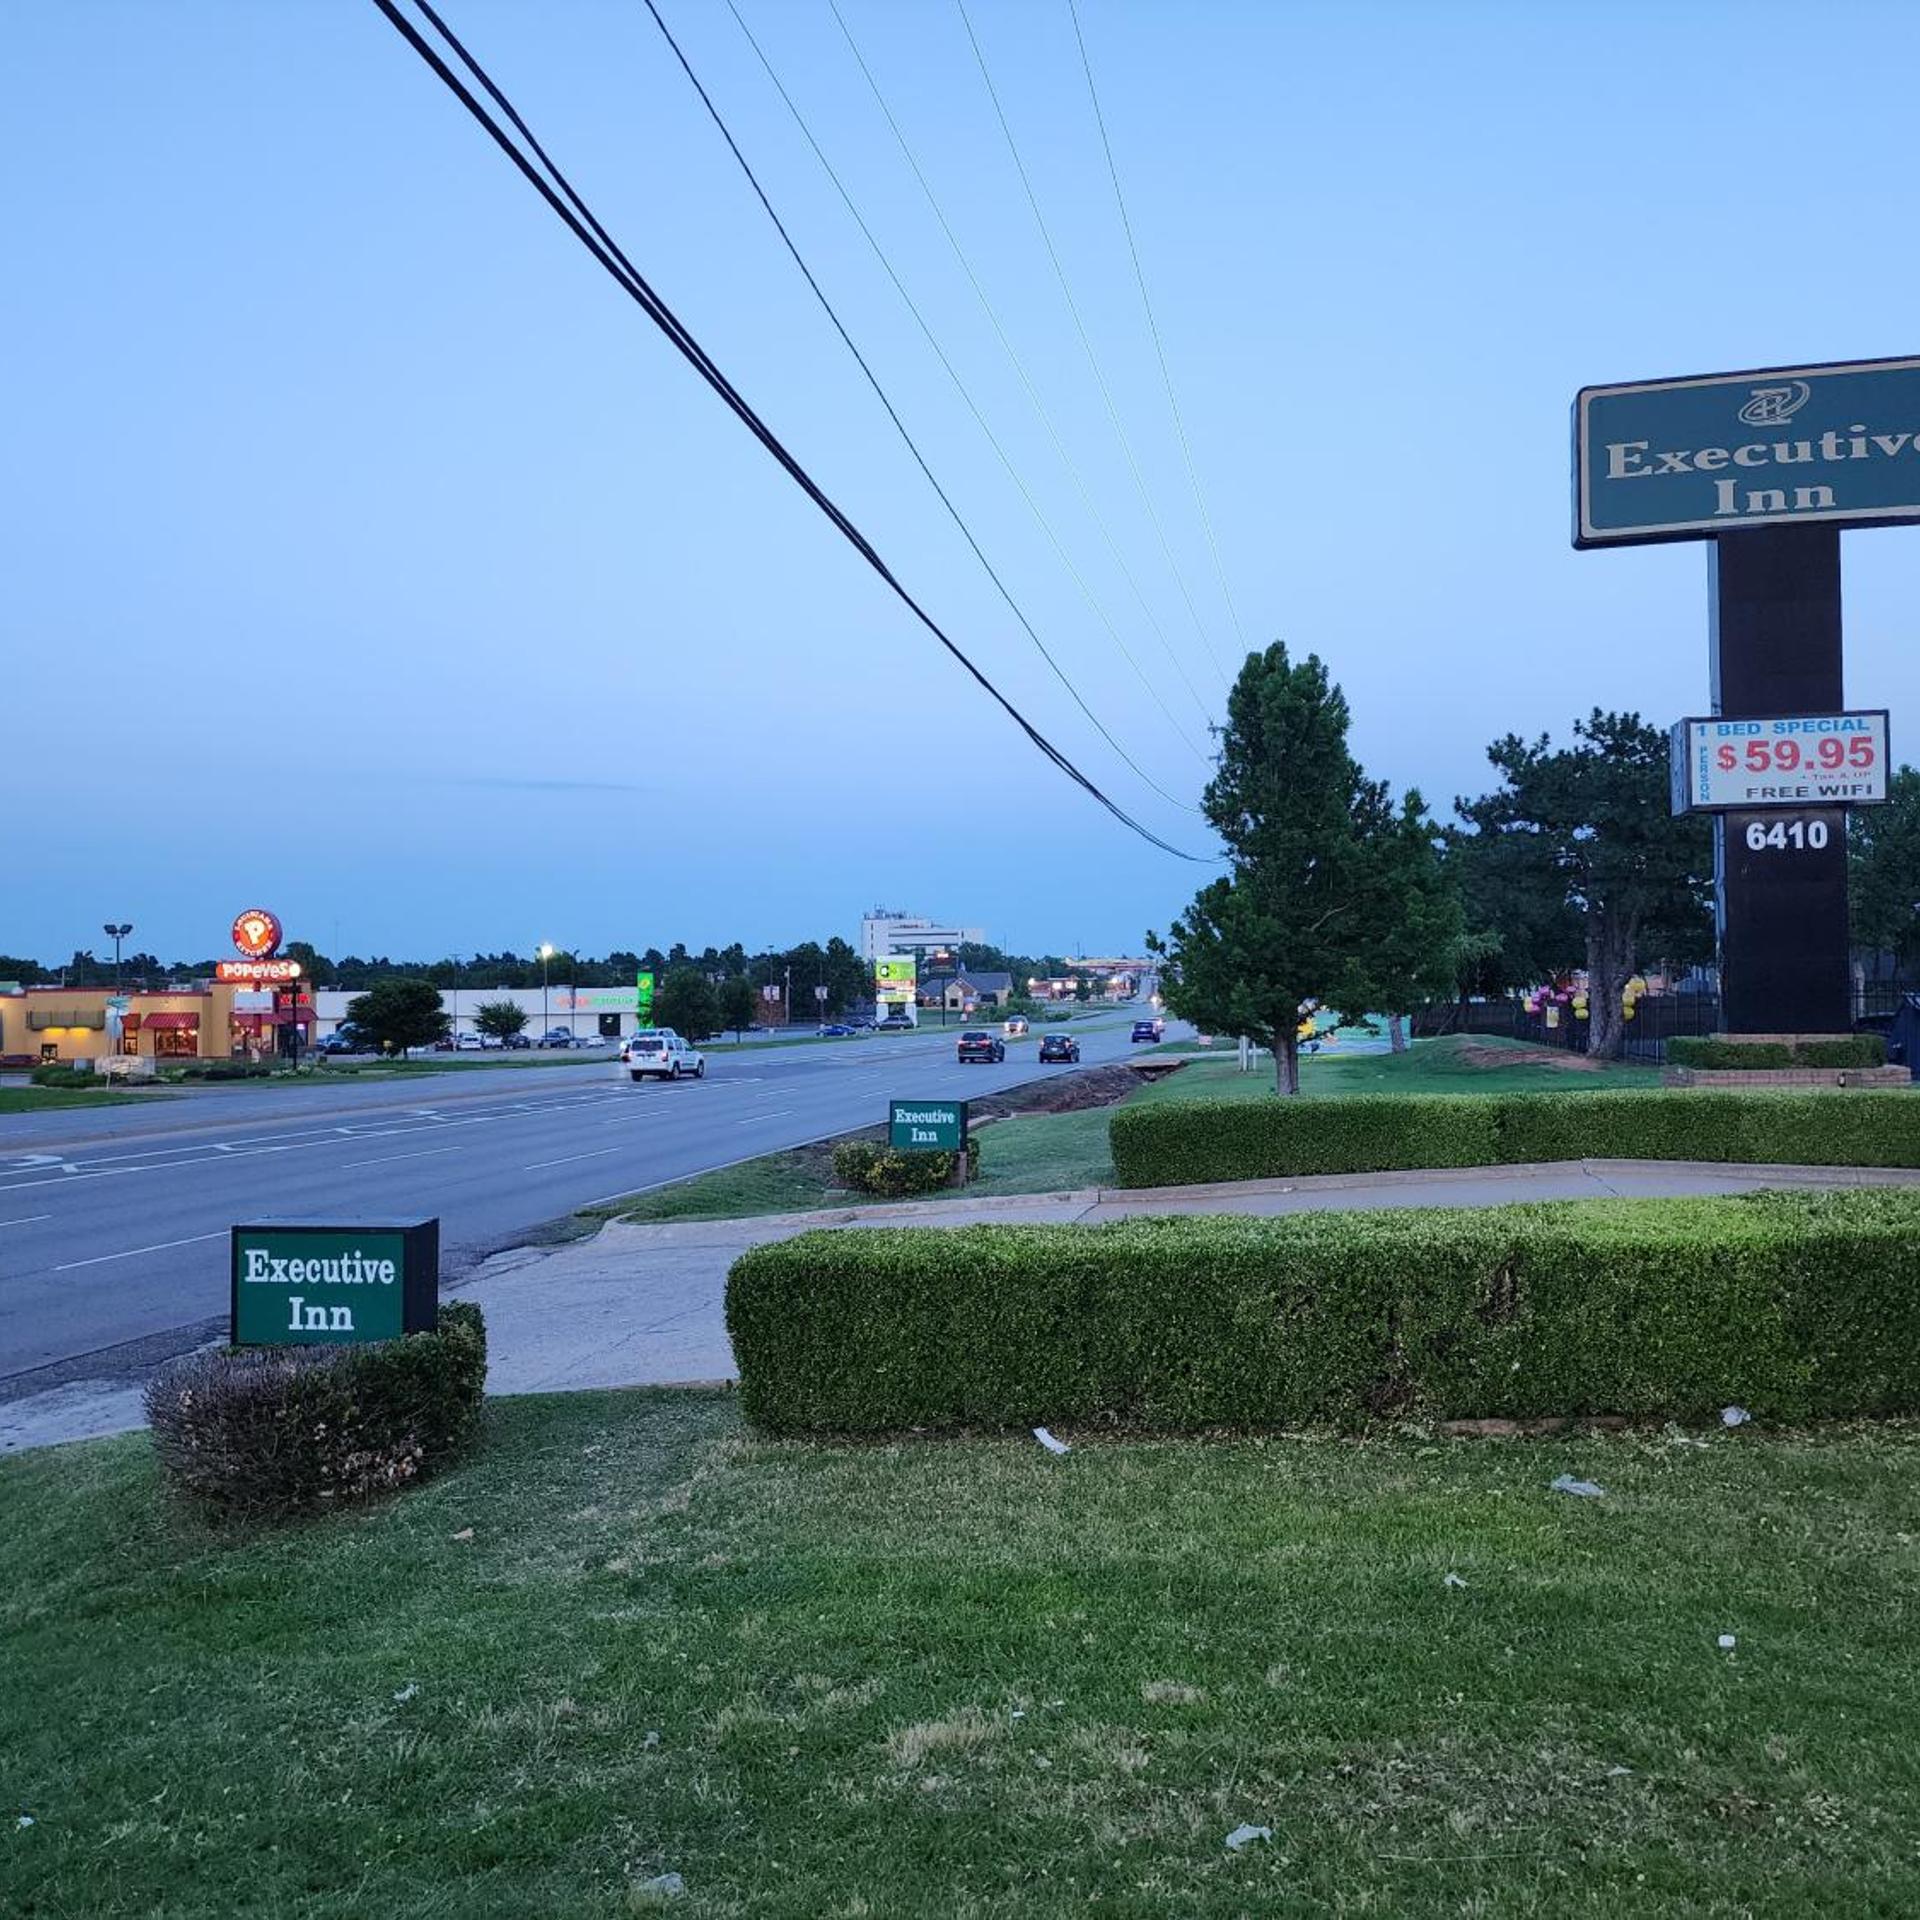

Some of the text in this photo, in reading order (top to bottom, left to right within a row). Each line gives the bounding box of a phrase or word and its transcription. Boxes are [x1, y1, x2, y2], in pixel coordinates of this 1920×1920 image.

[1605, 424, 1920, 479] Executiv
[1714, 478, 1837, 515] Inn
[1697, 718, 1870, 736] 1 BED SPECIAL
[1700, 746, 1710, 800] PERSON
[1746, 784, 1873, 798] FREE WIFI
[1746, 820, 1828, 850] 6410
[894, 1108, 956, 1124] Executive
[911, 1127, 938, 1142] Inn
[244, 1249, 395, 1284] Executive
[288, 1296, 355, 1331] Inn
